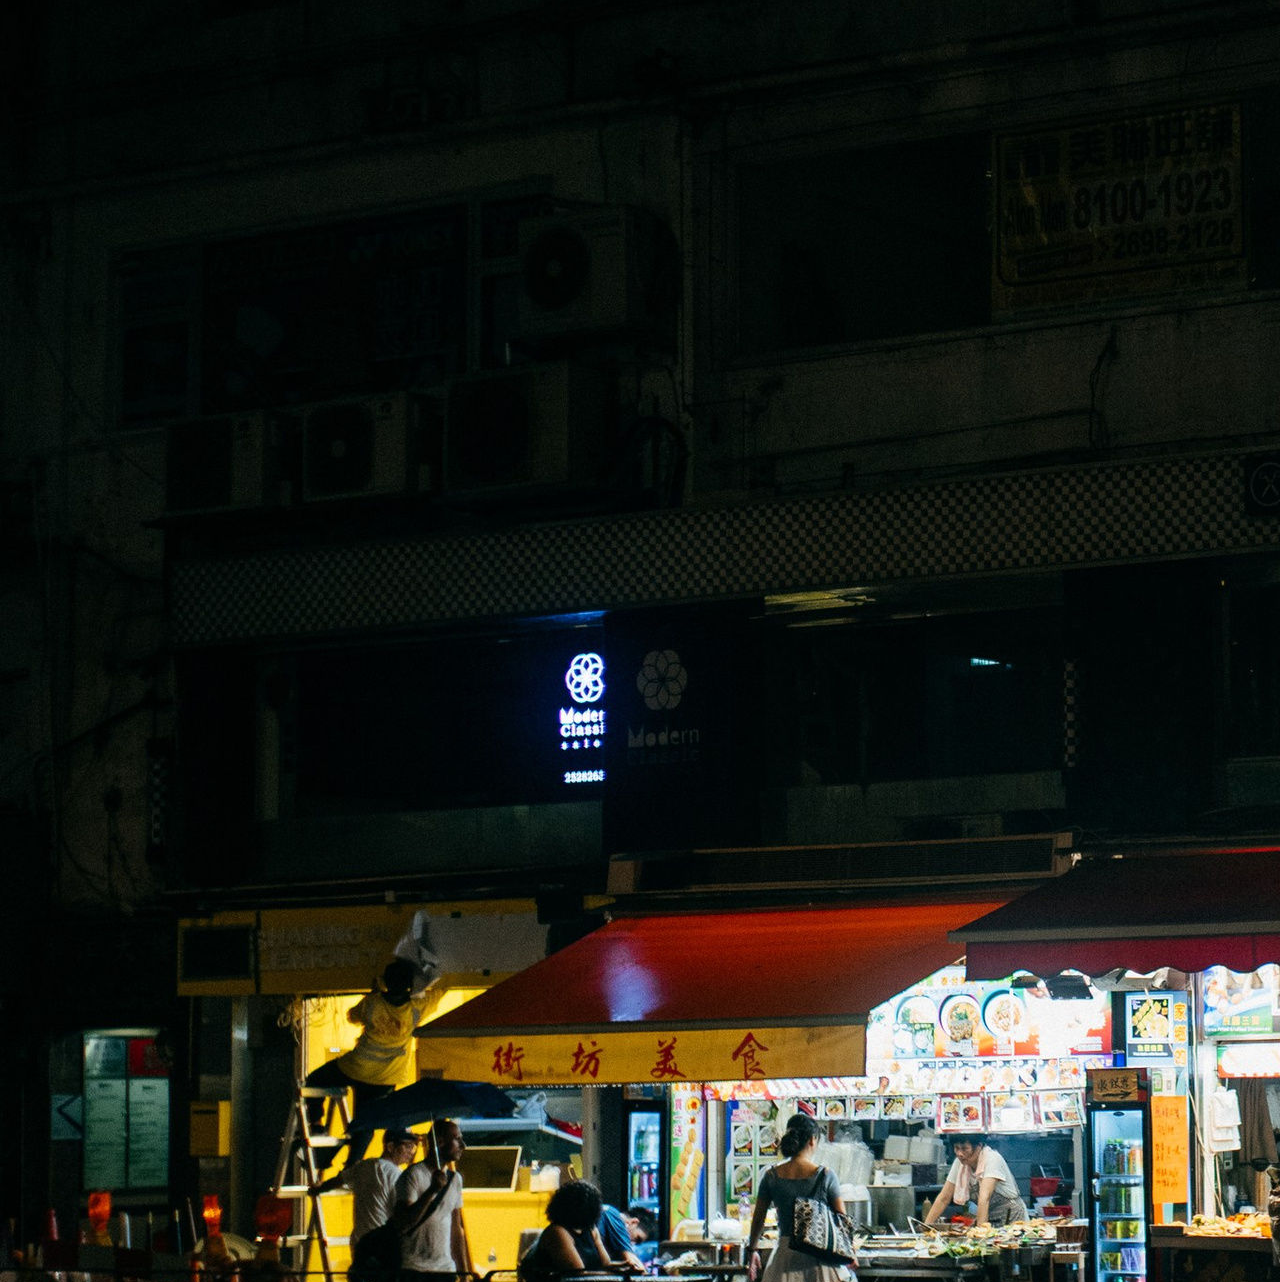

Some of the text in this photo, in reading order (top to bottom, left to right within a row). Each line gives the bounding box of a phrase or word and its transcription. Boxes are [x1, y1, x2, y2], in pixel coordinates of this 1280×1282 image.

[1072, 165, 1232, 230] 8100-1923
[1112, 217, 1234, 259] 2698-2128
[559, 706, 605, 725] Moder
[559, 721, 605, 738] Classi
[627, 723, 700, 748] Modern
[491, 1032, 770, 1080] 街坊美食
